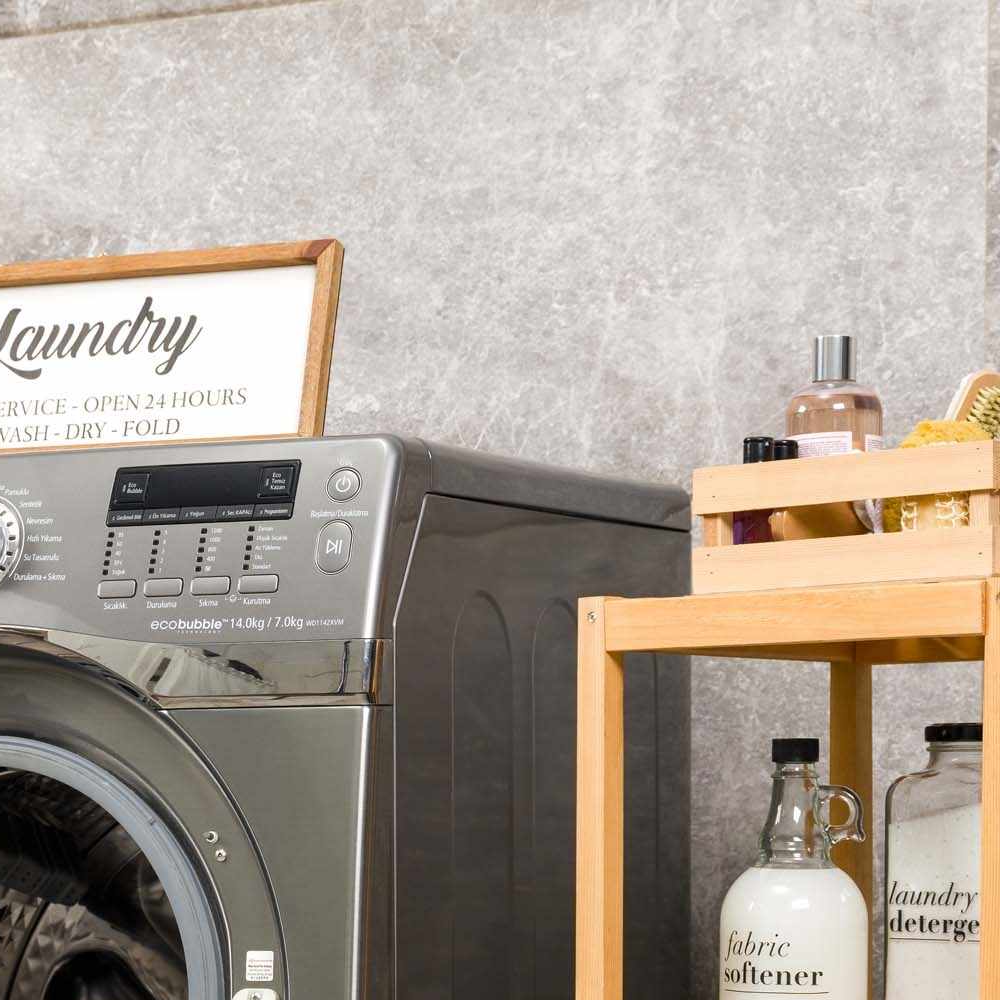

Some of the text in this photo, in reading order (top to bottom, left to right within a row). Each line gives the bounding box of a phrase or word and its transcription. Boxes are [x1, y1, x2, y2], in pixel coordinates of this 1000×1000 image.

[84, 393, 140, 414] OPEN
[144, 392, 166, 411] 24
[171, 387, 248, 409] HOURS
[65, 421, 107, 441] DRY
[123, 417, 181, 438] FOLD
[242, 596, 271, 605] Kurutma
[231, 617, 265, 631] 14.0kg
[274, 615, 304, 630] 7.0kg
[889, 881, 979, 913] laundry
[889, 909, 980, 942] deterge
[725, 931, 791, 962] fabric
[724, 961, 824, 986] softener
